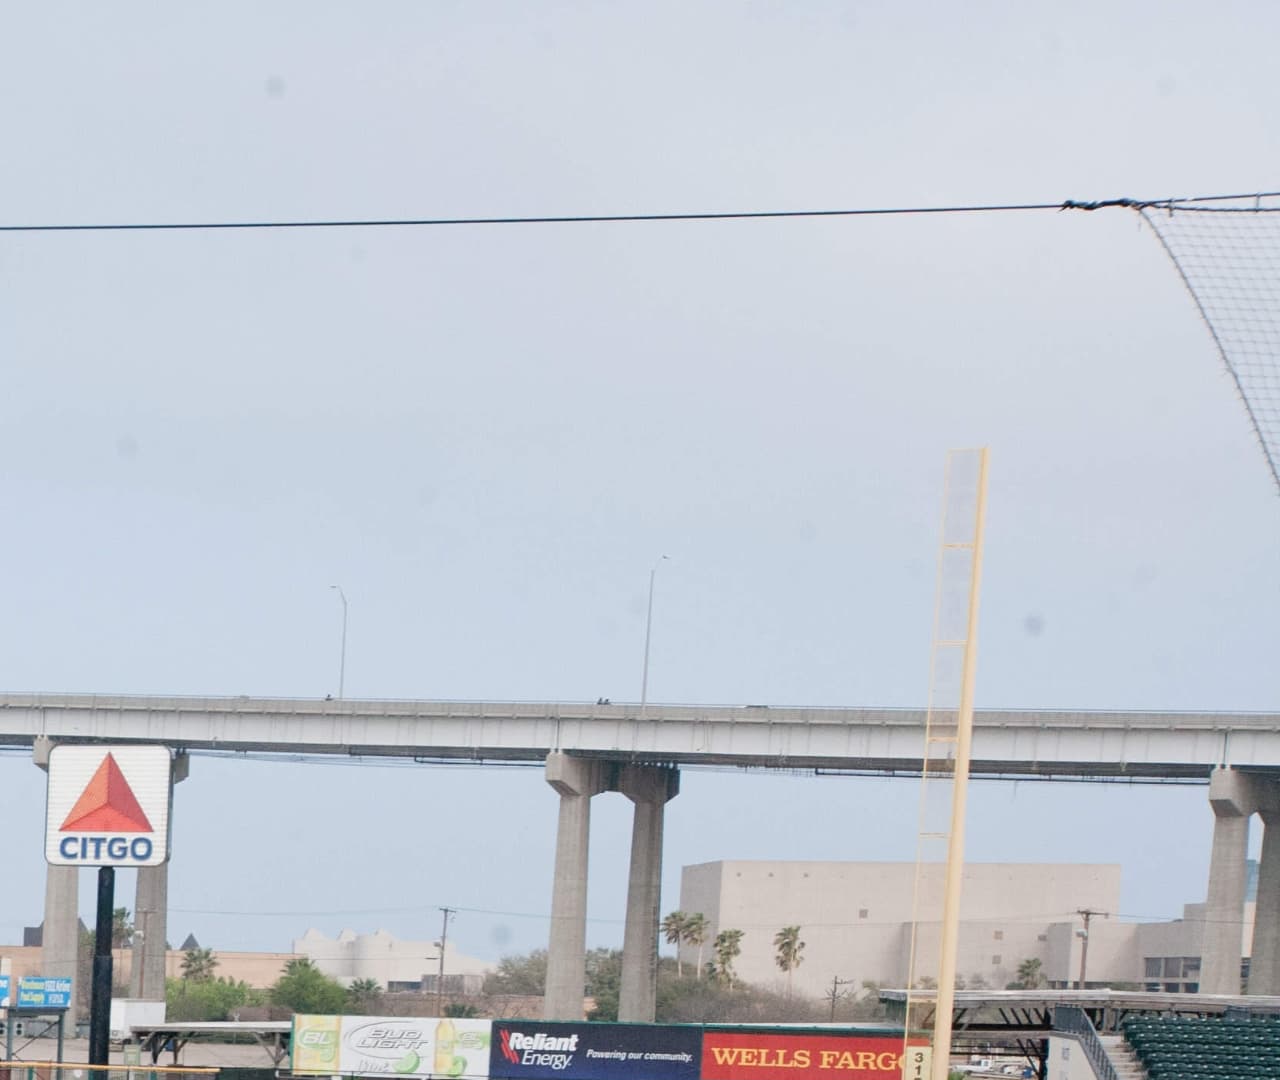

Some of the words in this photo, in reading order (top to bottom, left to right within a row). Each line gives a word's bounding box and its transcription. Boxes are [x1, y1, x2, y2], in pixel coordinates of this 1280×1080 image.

[59, 837, 153, 861] CITGO
[368, 1029, 423, 1039] BUD
[509, 1032, 579, 1051] Reliant
[356, 1039, 428, 1049] LIGHT
[586, 1049, 626, 1061] Powering
[629, 1052, 642, 1060] our
[644, 1051, 693, 1062] community.
[711, 1047, 811, 1068] WELLS
